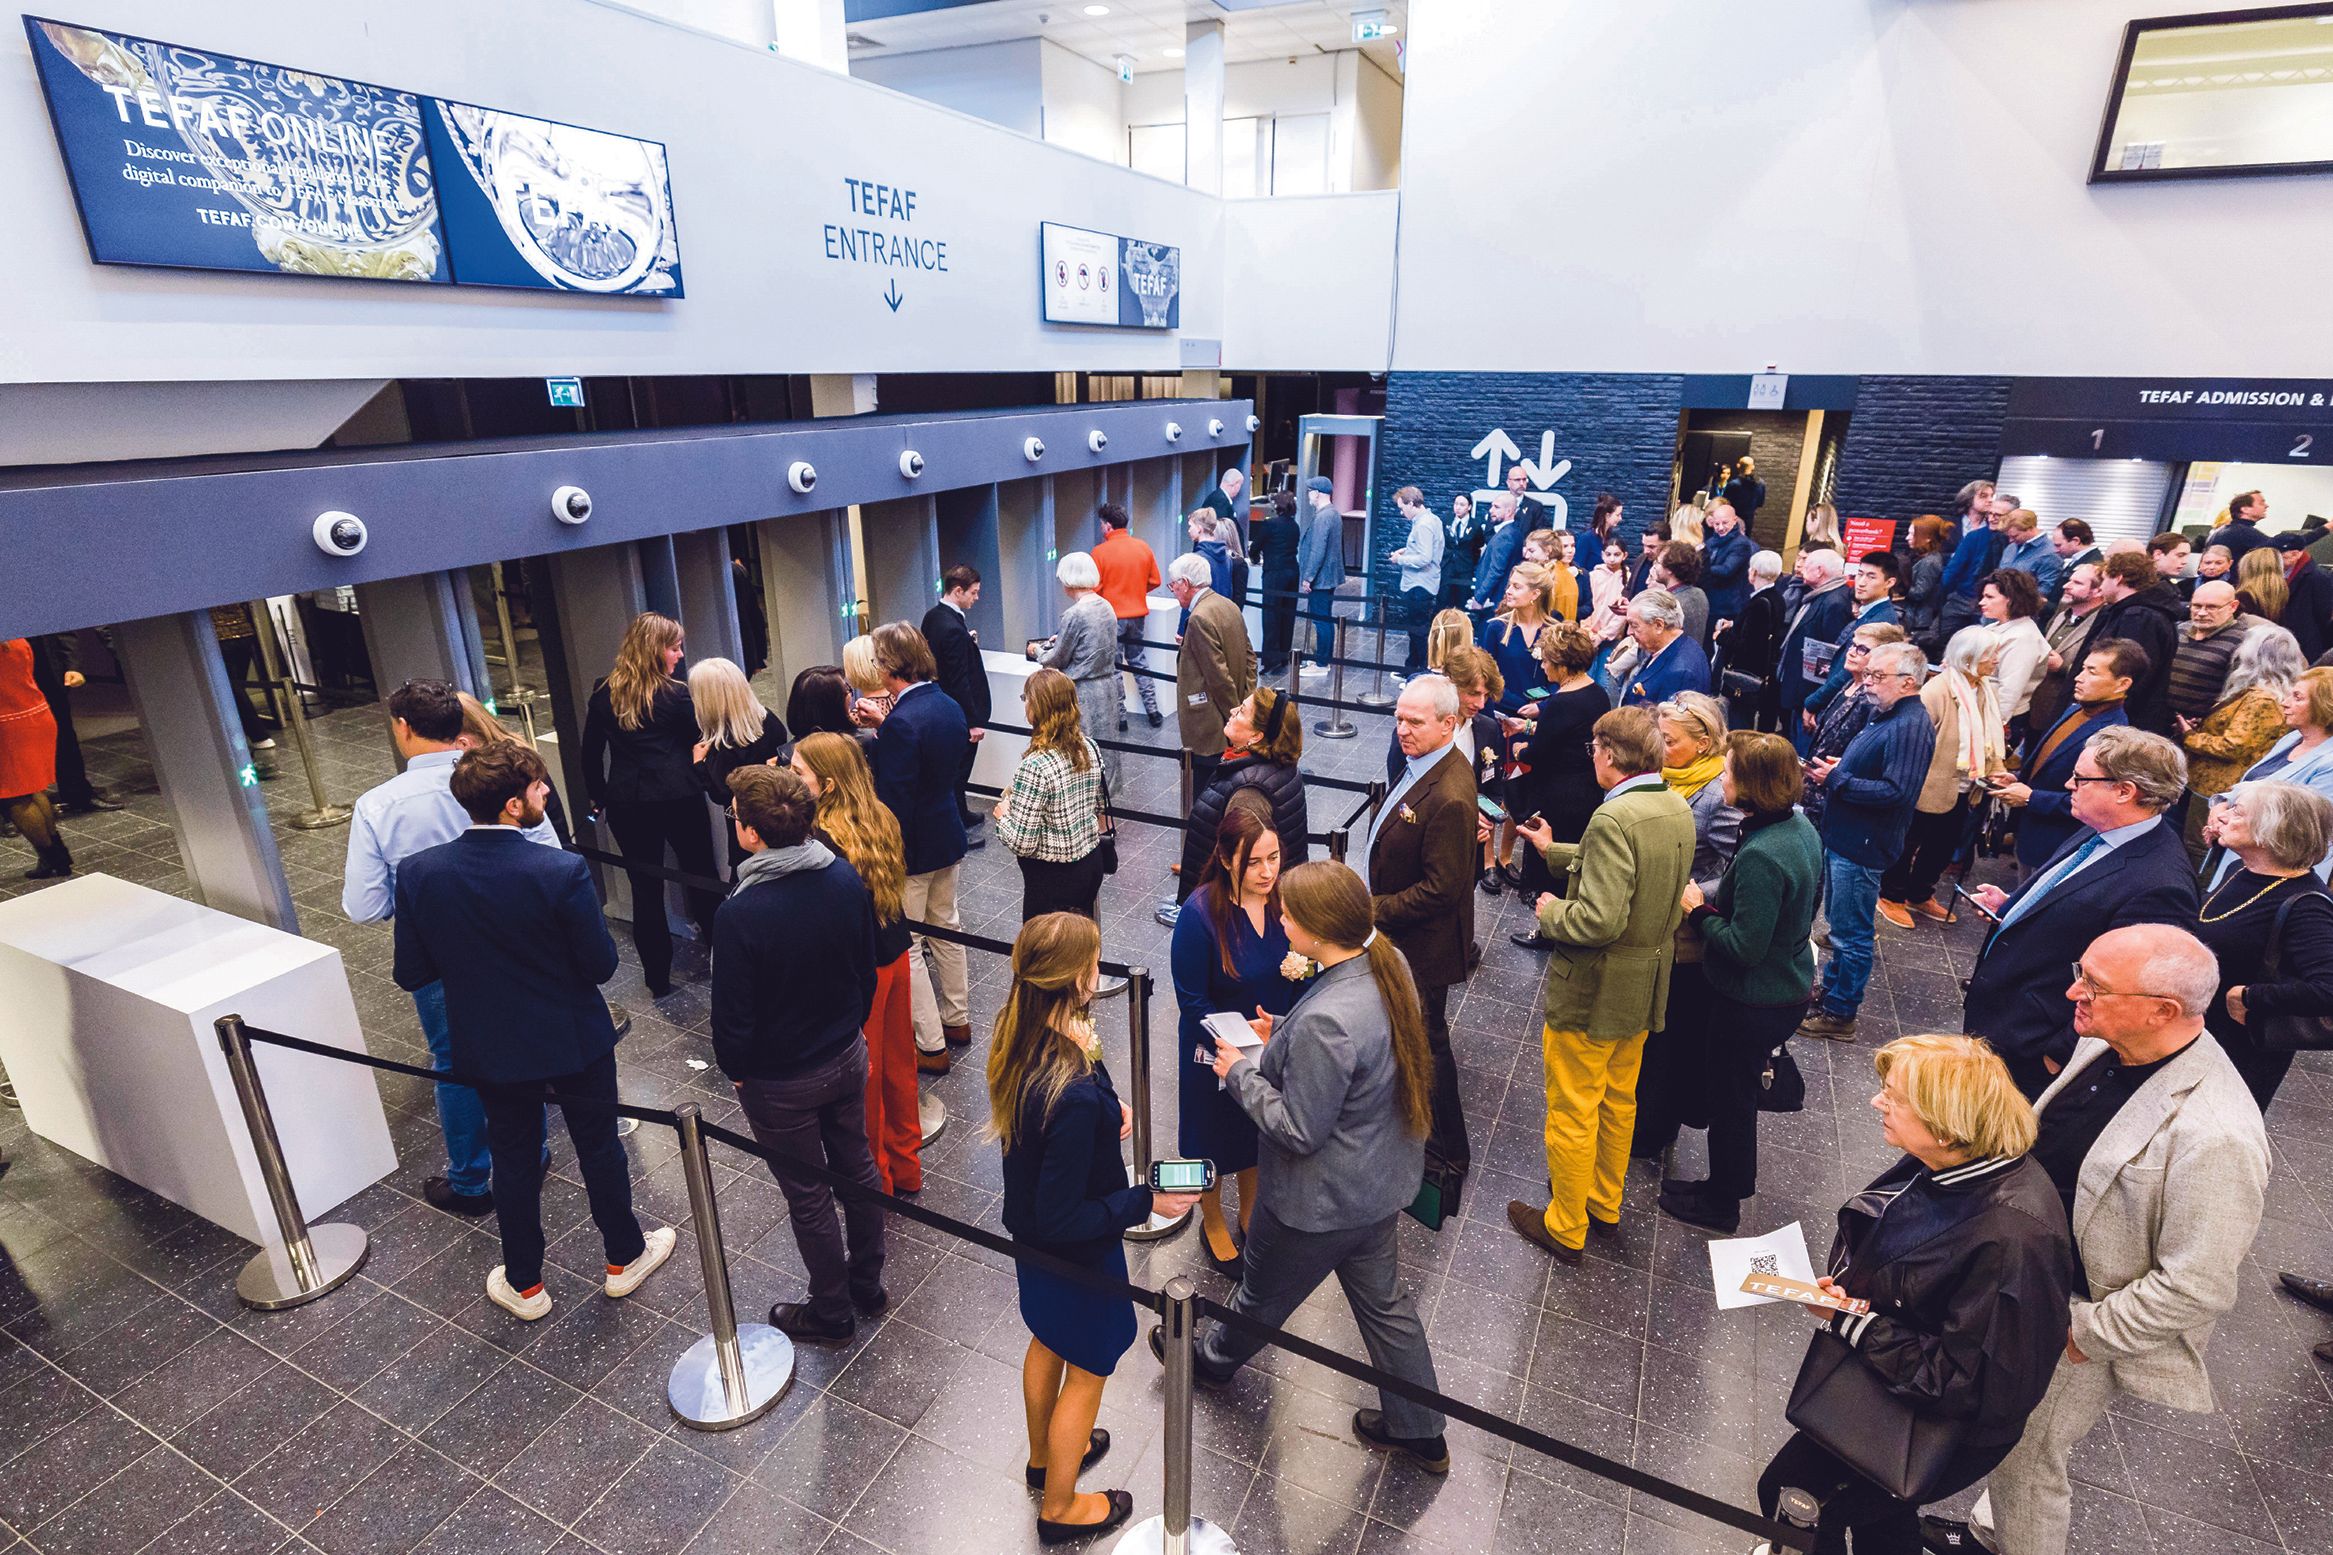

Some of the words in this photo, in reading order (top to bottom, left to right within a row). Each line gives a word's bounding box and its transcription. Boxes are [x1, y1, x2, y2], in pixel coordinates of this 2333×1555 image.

[102, 84, 250, 139] TEFAF
[261, 112, 393, 161] ONLINE
[124, 139, 196, 164] Discover
[200, 153, 281, 174] exceptional
[287, 161, 353, 186] highlights
[355, 173, 367, 187] in
[368, 172, 391, 190] the
[122, 163, 176, 187] digital
[178, 174, 261, 196] companion
[266, 183, 282, 197] to
[283, 182, 335, 202] TEFAF
[844, 177, 917, 221] TEFAF
[196, 208, 361, 237] TEFAF.COM/ONLINE
[823, 224, 948, 272] ENTRANCE
[1132, 272, 1167, 297] TEFAF
[2139, 390, 2194, 404] TEFAF
[2196, 391, 2305, 406] ADMISSION
[2309, 393, 2324, 406] &
[2091, 428, 2105, 450] 1
[2288, 434, 2314, 457] 2
[1750, 1282, 1835, 1303] TEFAF
[1790, 1497, 1810, 1510] TEFAF
